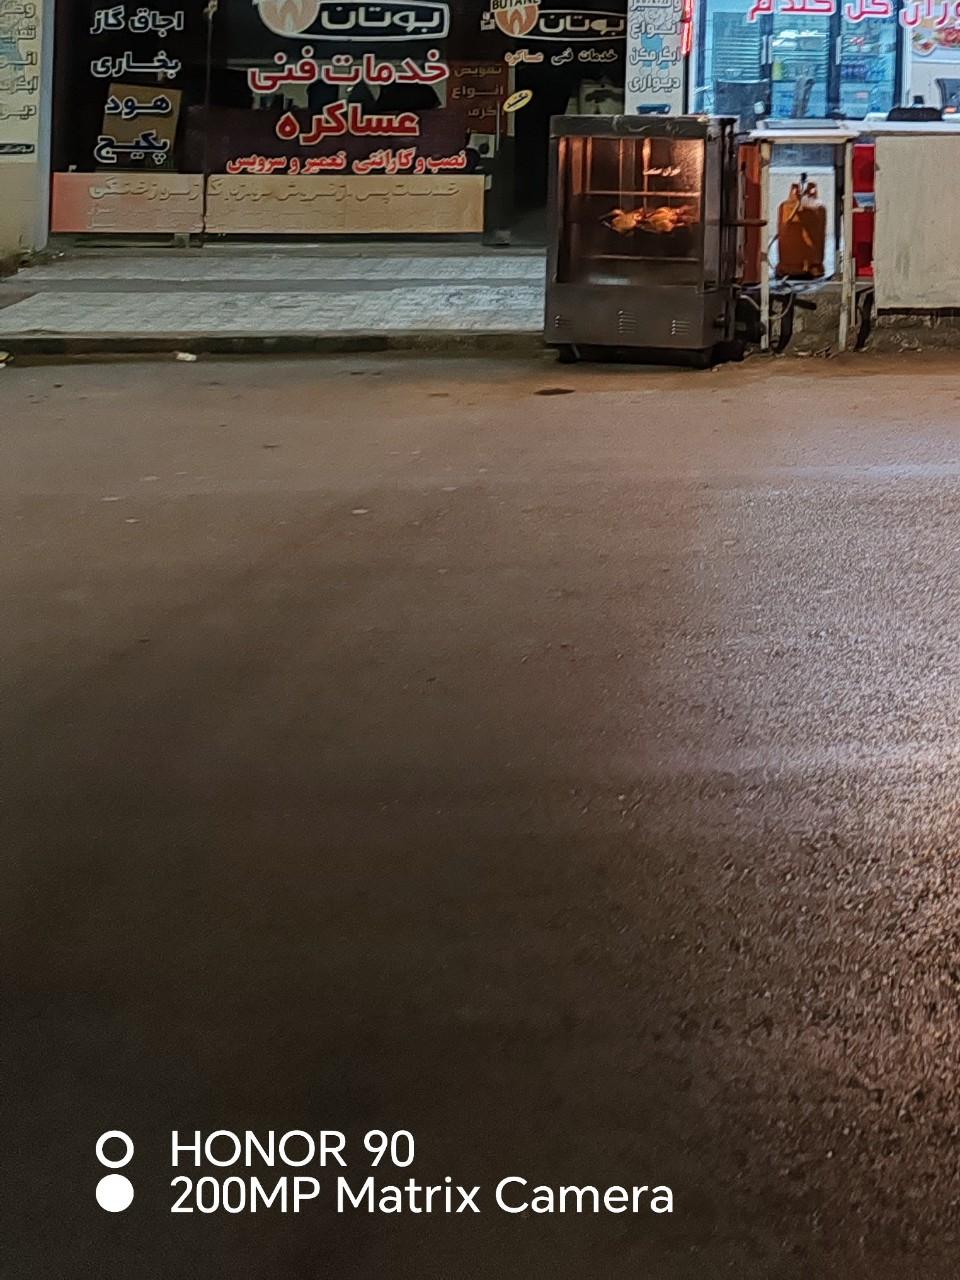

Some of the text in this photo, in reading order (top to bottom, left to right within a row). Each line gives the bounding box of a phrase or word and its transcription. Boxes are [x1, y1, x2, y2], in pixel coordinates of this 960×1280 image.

[90, 5, 184, 37] اجاق گاز
[321, 6, 441, 33] بوتان
[539, 15, 625, 36] بوتان
[90, 51, 182, 79] بخاری
[248, 45, 450, 92] خدمات فنی
[105, 95, 172, 119] هود
[276, 100, 420, 145] عساکره
[94, 129, 171, 165] پکیج
